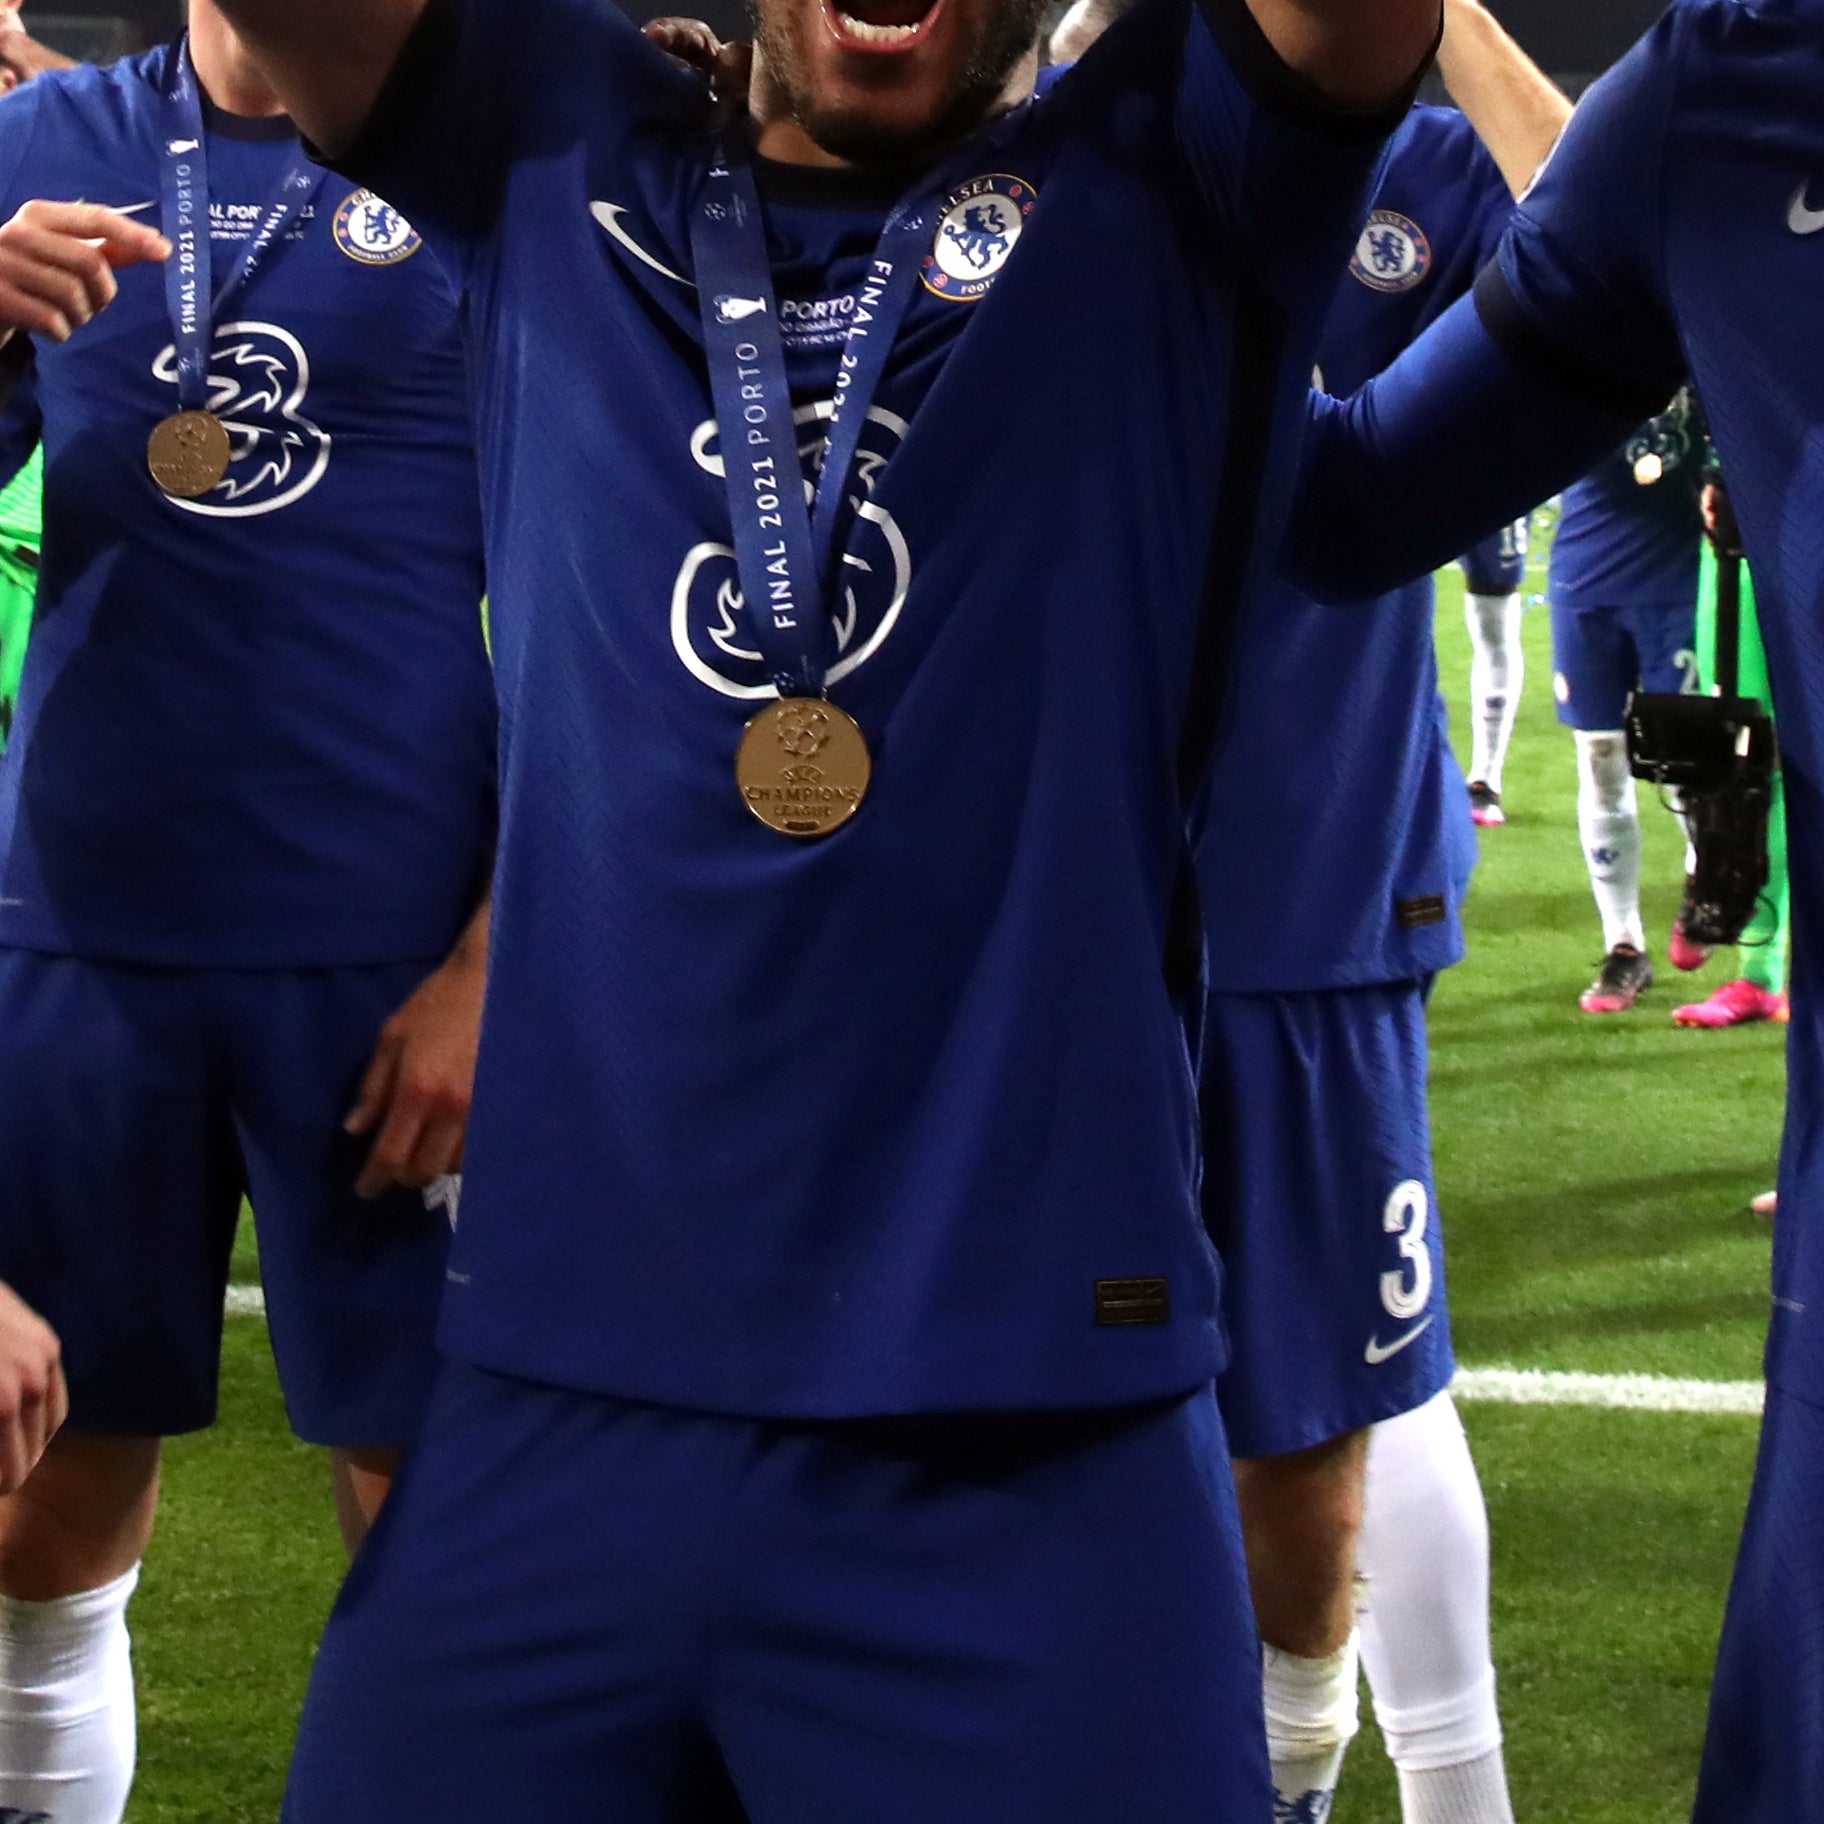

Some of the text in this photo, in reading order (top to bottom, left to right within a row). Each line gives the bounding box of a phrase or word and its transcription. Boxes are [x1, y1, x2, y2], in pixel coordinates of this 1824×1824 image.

[175, 162, 197, 334] FINAL 2021 PORTO
[852, 260, 893, 341] FINAL
[781, 294, 855, 319] PORTO
[734, 342, 797, 629] FINAL 2021 PORTO
[744, 784, 861, 802] CHAMPIONS
[1378, 1177, 1433, 1320] 3
